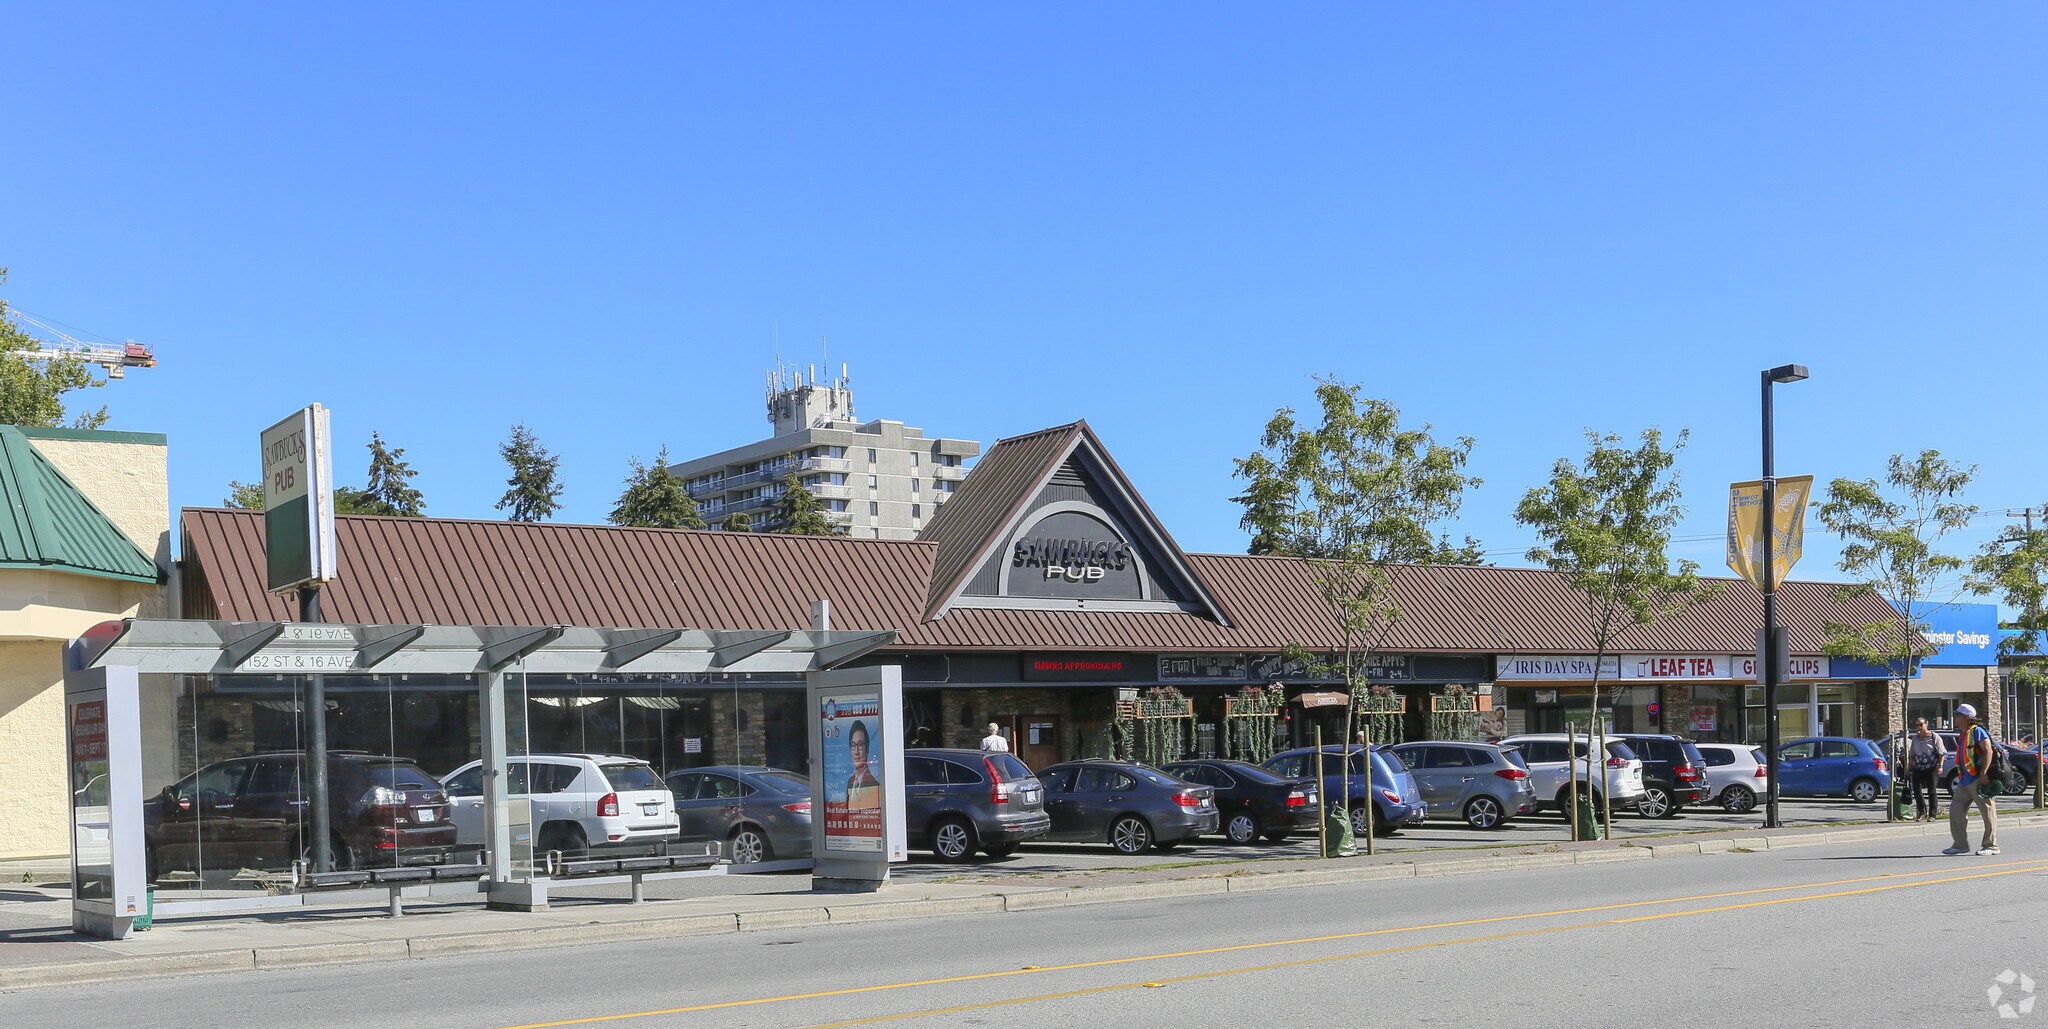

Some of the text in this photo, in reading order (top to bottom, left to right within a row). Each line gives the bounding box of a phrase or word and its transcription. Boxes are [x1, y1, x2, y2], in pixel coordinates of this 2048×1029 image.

[275, 466, 295, 495] PUB
[1020, 537, 1132, 566] SAWBUCKS
[1047, 565, 1105, 579] PUB
[1956, 630, 1990, 650] Savings
[248, 656, 353, 668] 152 ST & 16 AVE
[1516, 660, 1542, 674] IRIS
[1544, 660, 1570, 674] DAY
[1570, 660, 1592, 674] SPA
[1651, 658, 1715, 677] LEAF TEA
[1789, 659, 1819, 675] CLIPS
